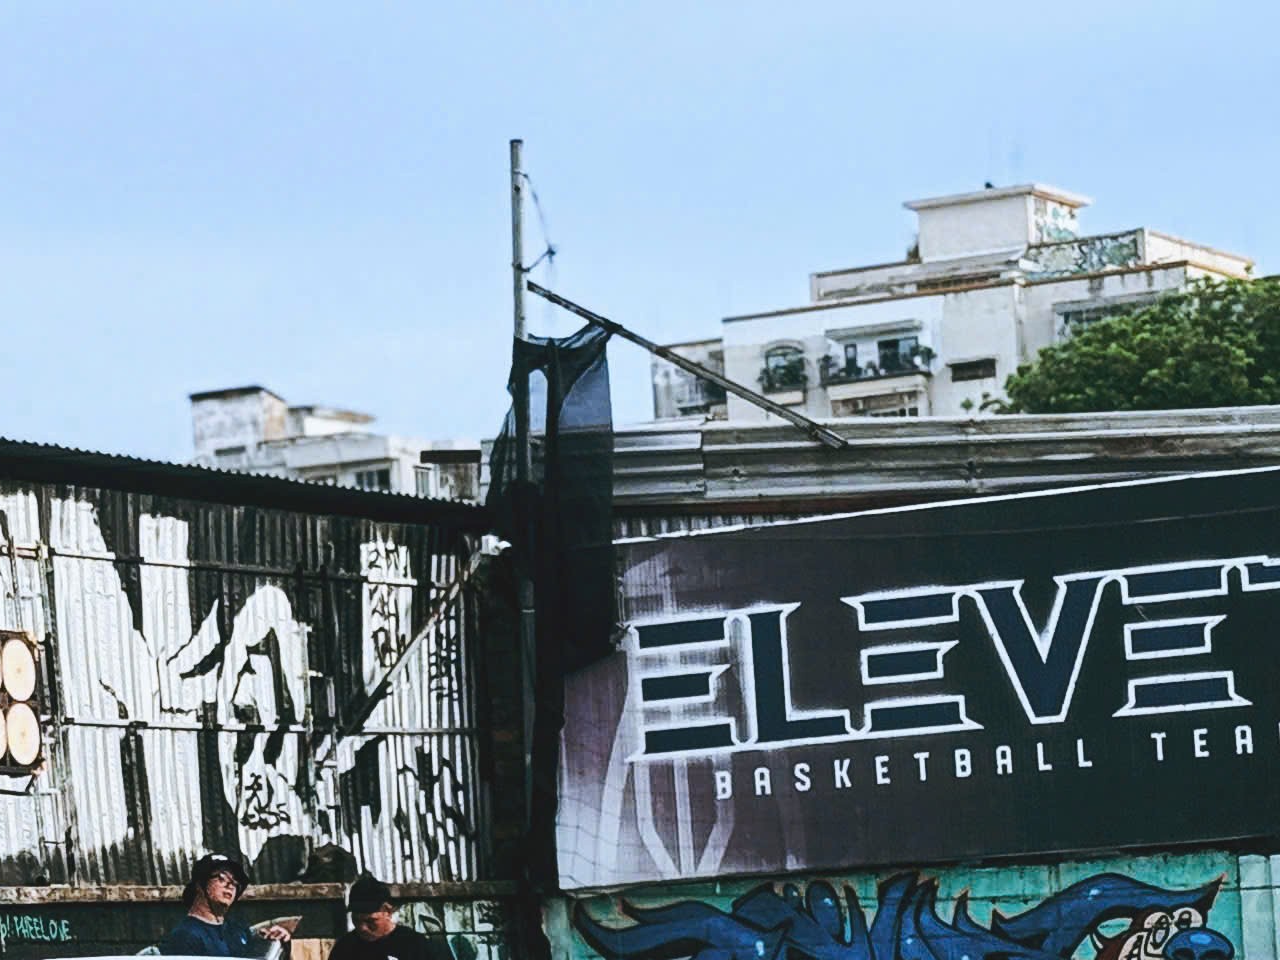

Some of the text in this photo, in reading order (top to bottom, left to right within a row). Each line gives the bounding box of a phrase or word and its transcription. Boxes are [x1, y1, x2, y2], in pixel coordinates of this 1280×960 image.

[625, 557, 1280, 762] ELEVE
[716, 723, 1280, 800] BASKETBALL TEA
